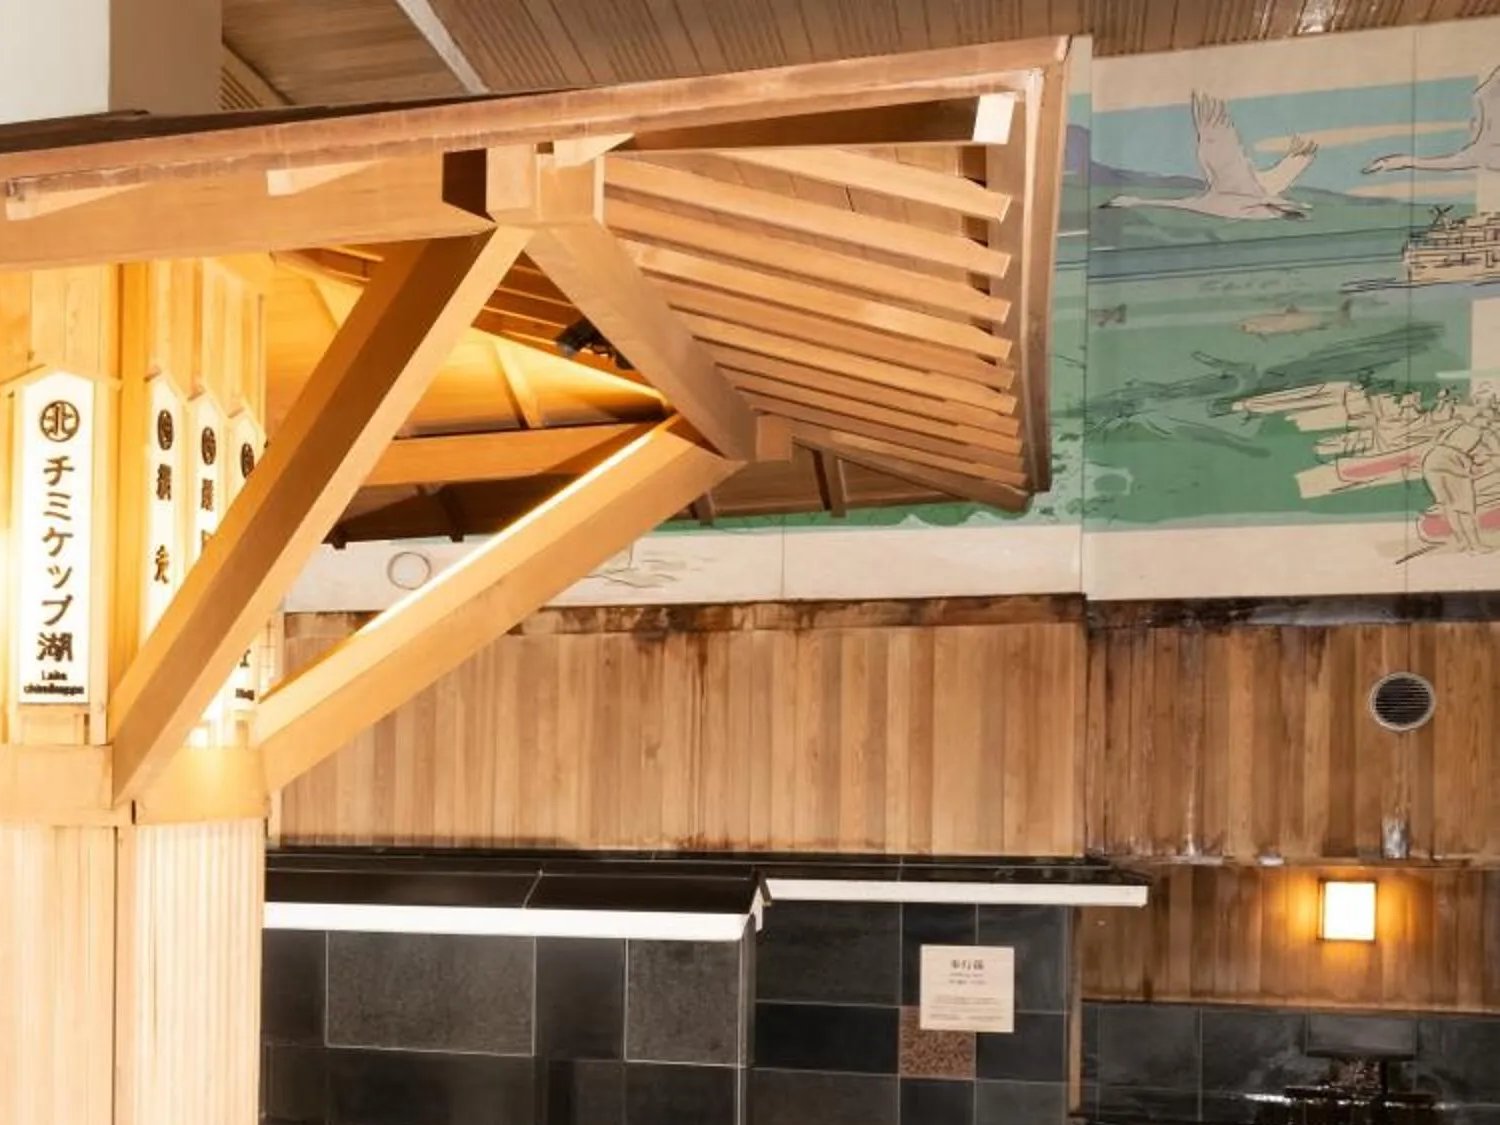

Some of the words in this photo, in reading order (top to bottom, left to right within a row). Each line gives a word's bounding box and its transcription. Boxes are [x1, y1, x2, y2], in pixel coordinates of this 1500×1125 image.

[36, 456, 75, 662] チミケップ湖
